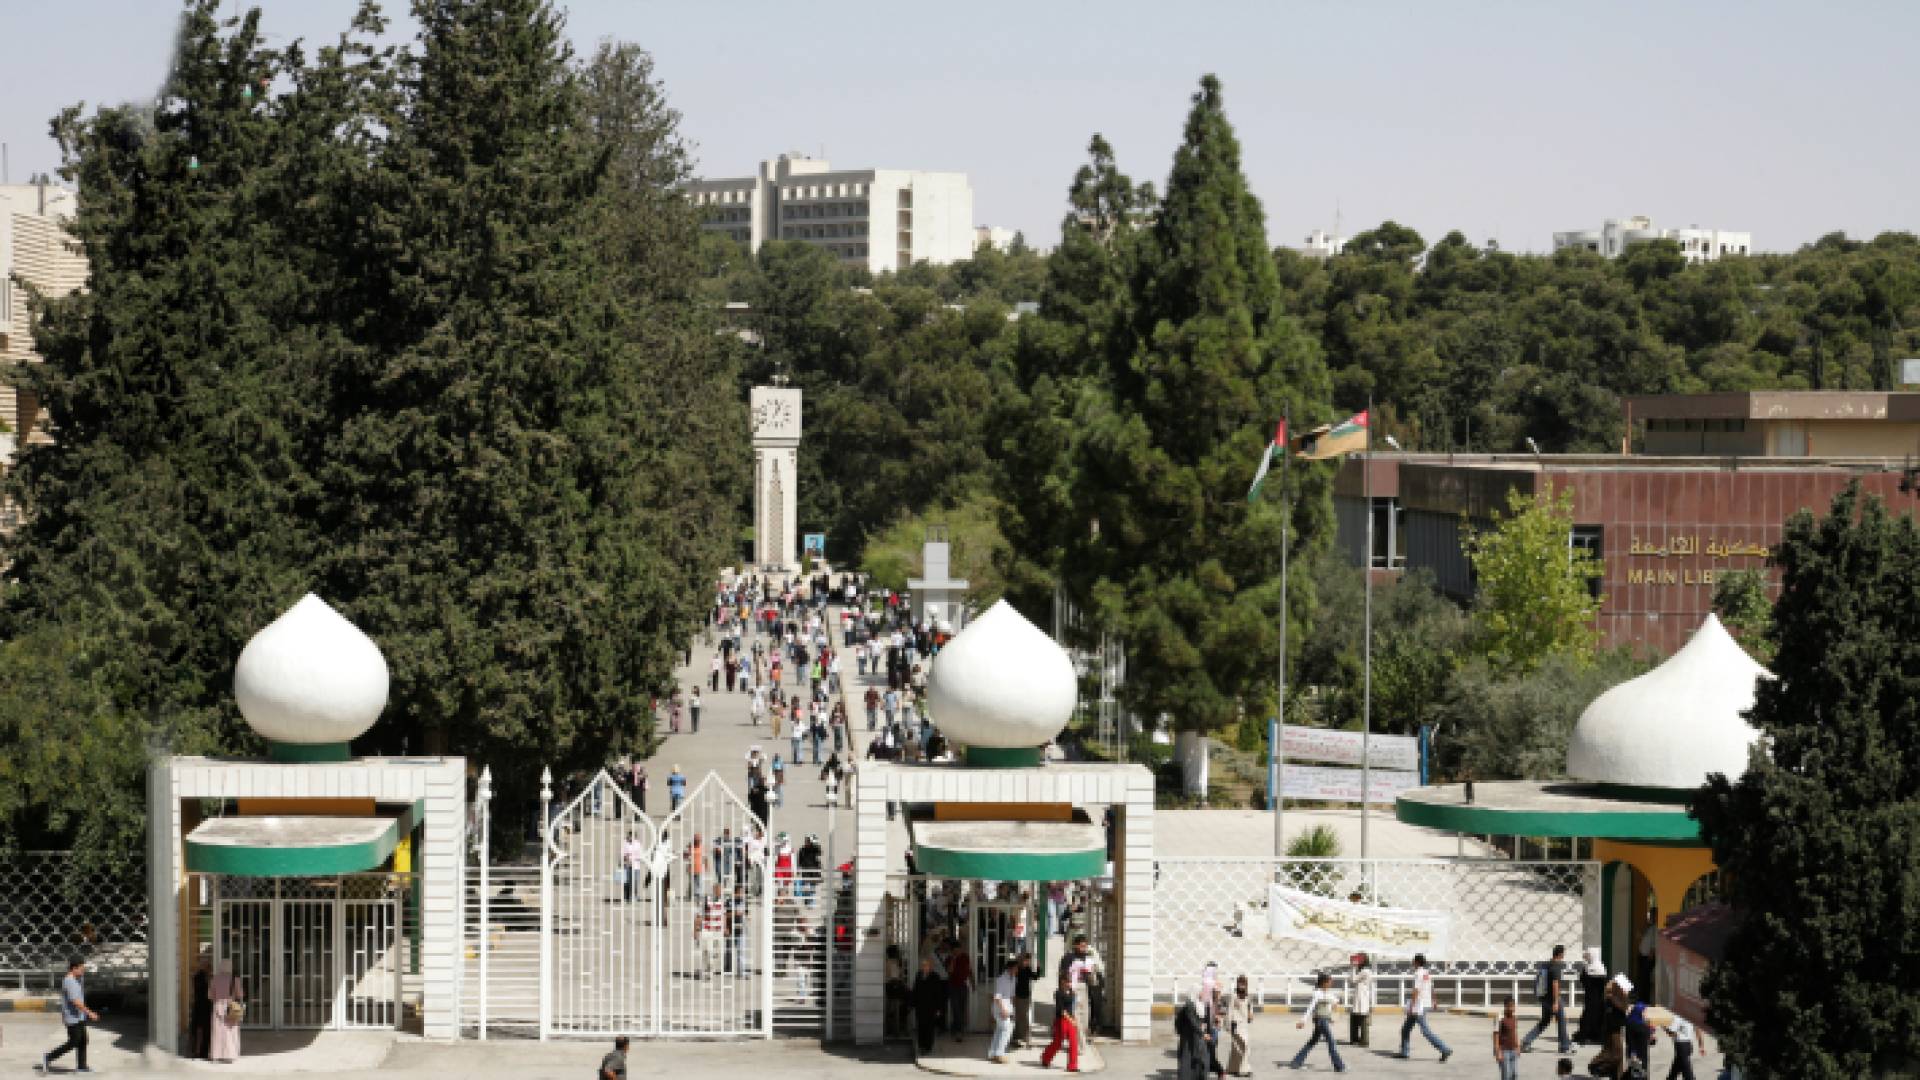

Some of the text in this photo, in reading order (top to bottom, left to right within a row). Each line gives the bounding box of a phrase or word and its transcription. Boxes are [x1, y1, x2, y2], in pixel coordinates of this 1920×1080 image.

[1630, 536, 1769, 559] مكتبة الجامعة
[1628, 569, 1714, 584] MAIN LIB
